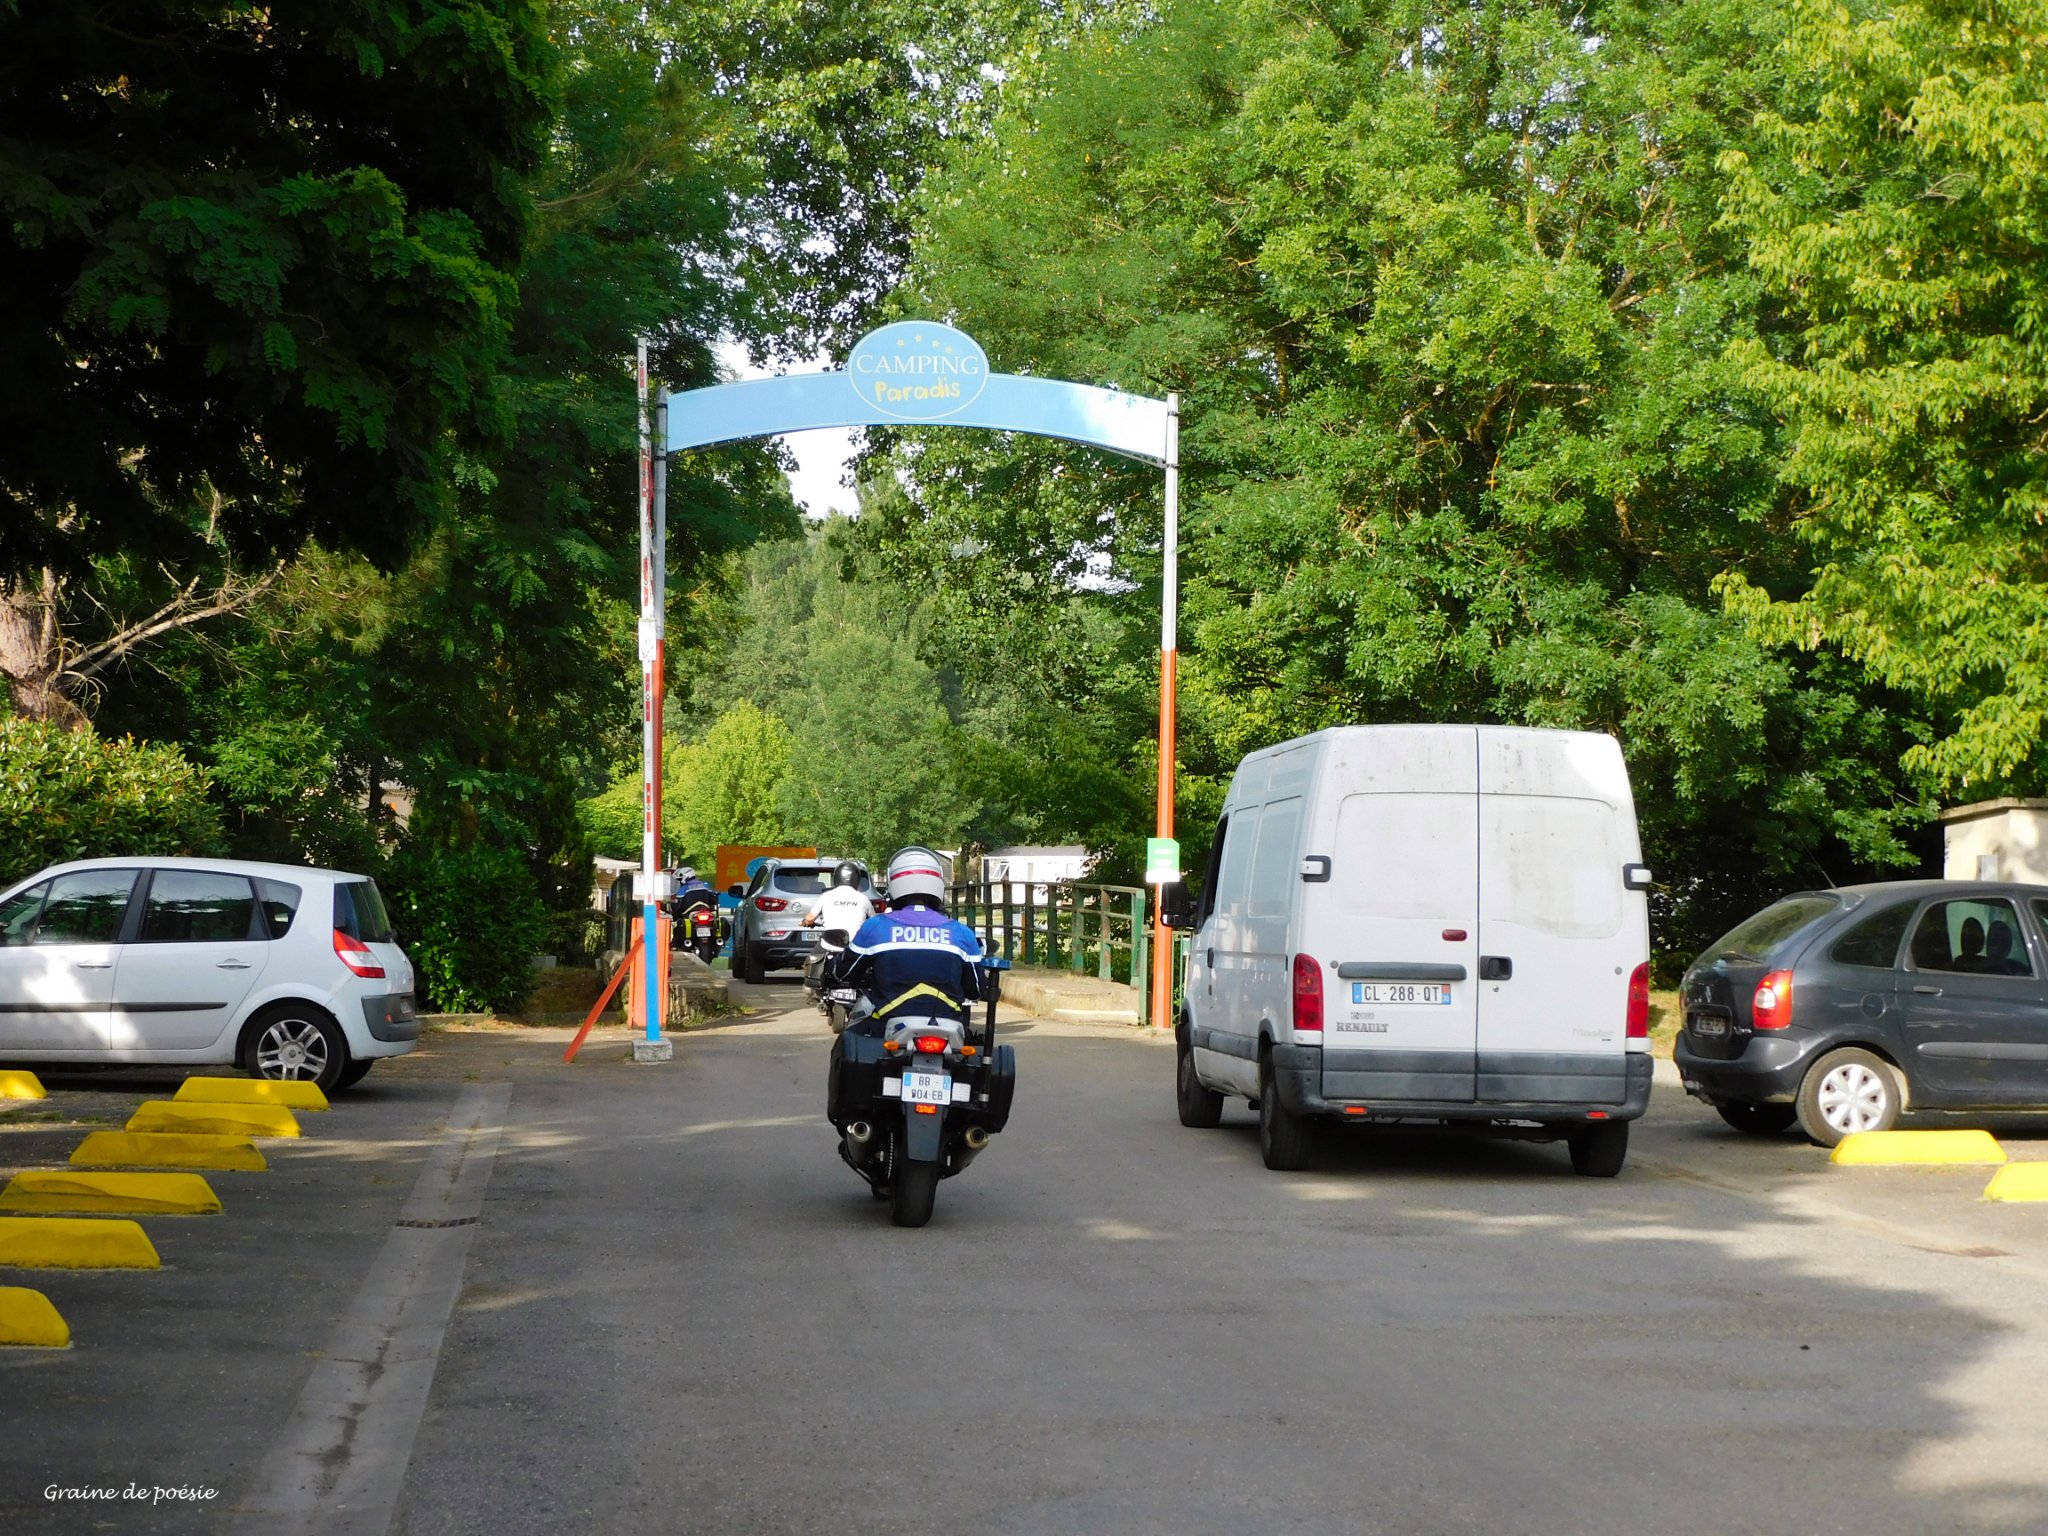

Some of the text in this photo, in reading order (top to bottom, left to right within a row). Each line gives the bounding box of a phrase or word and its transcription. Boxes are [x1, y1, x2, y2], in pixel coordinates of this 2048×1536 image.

[856, 354, 979, 375] CAMPING
[875, 376, 960, 402] Paradis
[891, 926, 950, 944] POLICE
[1364, 985, 1440, 1002] CL-288-QT
[1336, 1022, 1389, 1033] RENAULT
